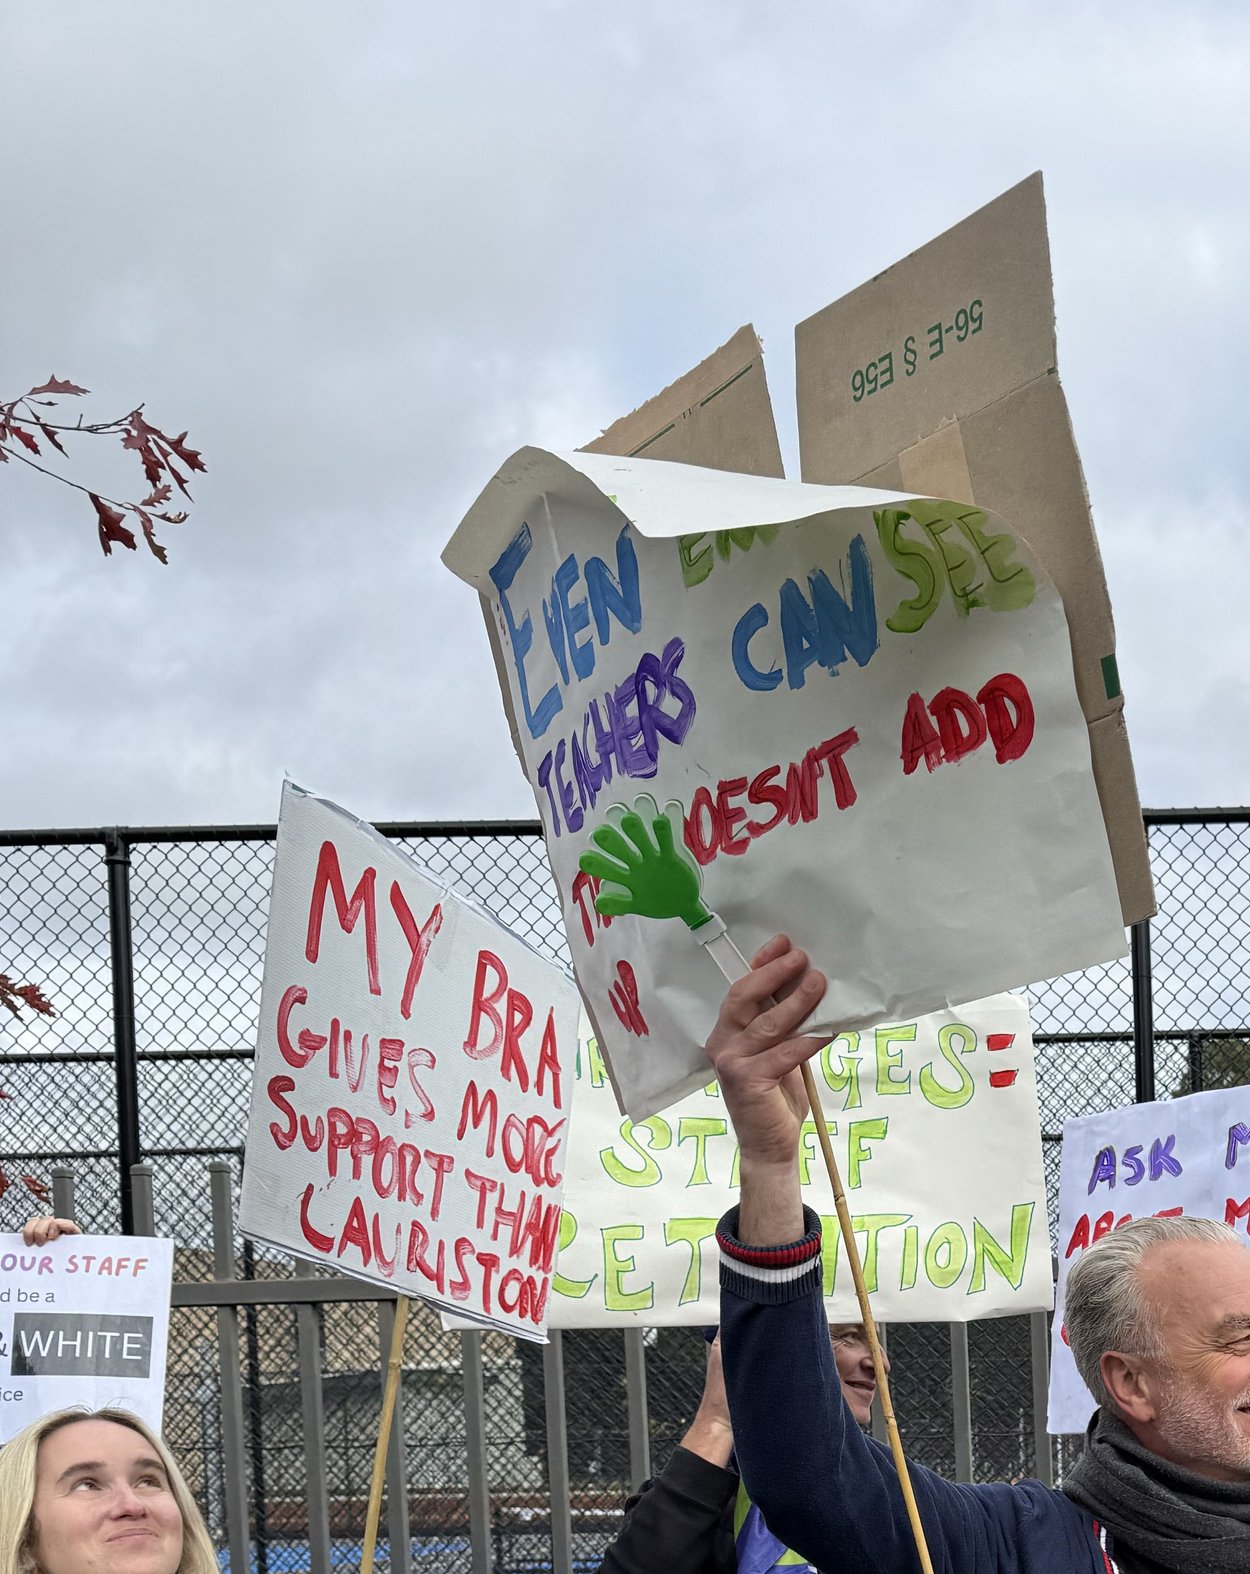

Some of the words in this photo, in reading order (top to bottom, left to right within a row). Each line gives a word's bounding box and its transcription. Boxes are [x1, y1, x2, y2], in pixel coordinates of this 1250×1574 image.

[852, 354, 895, 402] E56
[489, 521, 643, 740] EVEN
[538, 636, 697, 838] TEACHERS
[732, 533, 880, 692] CAN
[875, 499, 1038, 632] SEE
[900, 672, 1036, 774] ADD
[305, 840, 442, 1019] MY
[463, 950, 562, 1110] BRA
[608, 959, 650, 1037] UP
[276, 985, 437, 1129] GIVES
[267, 1074, 454, 1222] SUPPORT
[464, 1168, 561, 1275] THAN
[1088, 1134, 1183, 1196] ASK
[17, 1288, 40, 1303] be
[45, 1291, 55, 1303] a
[65, 1254, 149, 1278] STAFF
[299, 1184, 550, 1325] LAURISTON
[20, 1330, 144, 1361] WHITE
